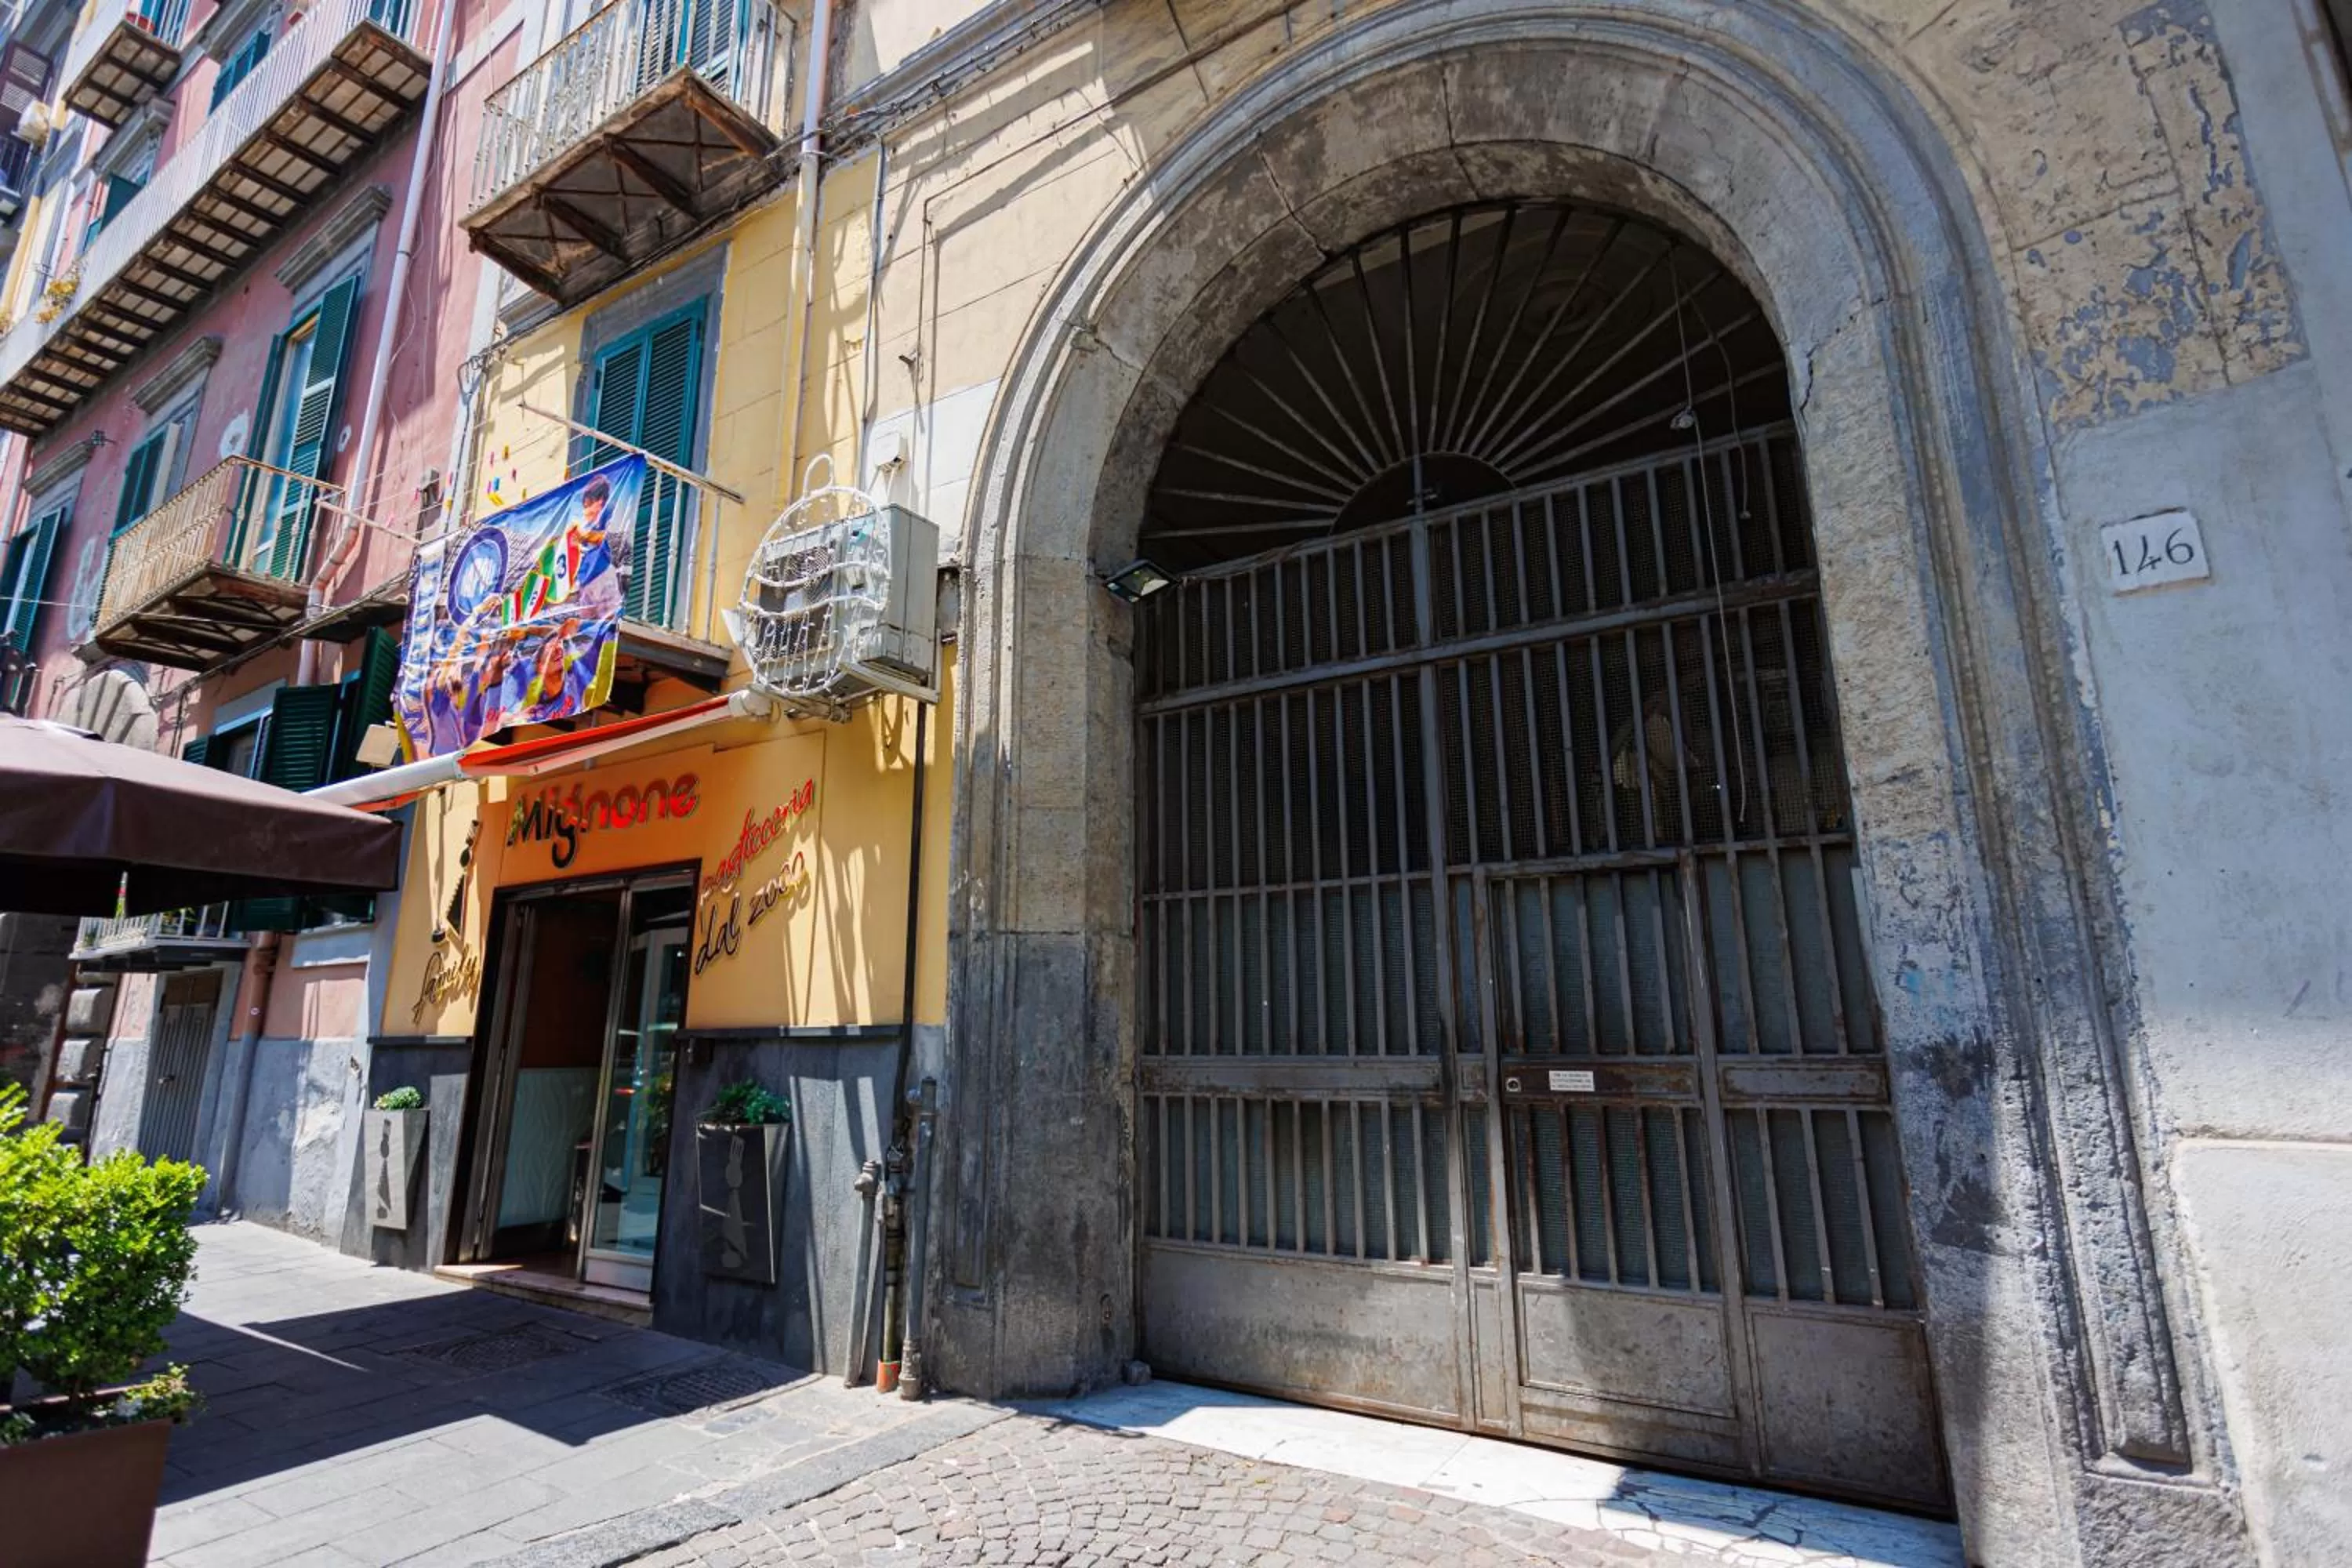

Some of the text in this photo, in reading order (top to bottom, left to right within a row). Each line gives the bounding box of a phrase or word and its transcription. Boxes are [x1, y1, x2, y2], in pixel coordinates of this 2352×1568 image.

[2113, 526, 2194, 575] 146
[506, 772, 700, 869] Mignone
[695, 891, 742, 975] dal
